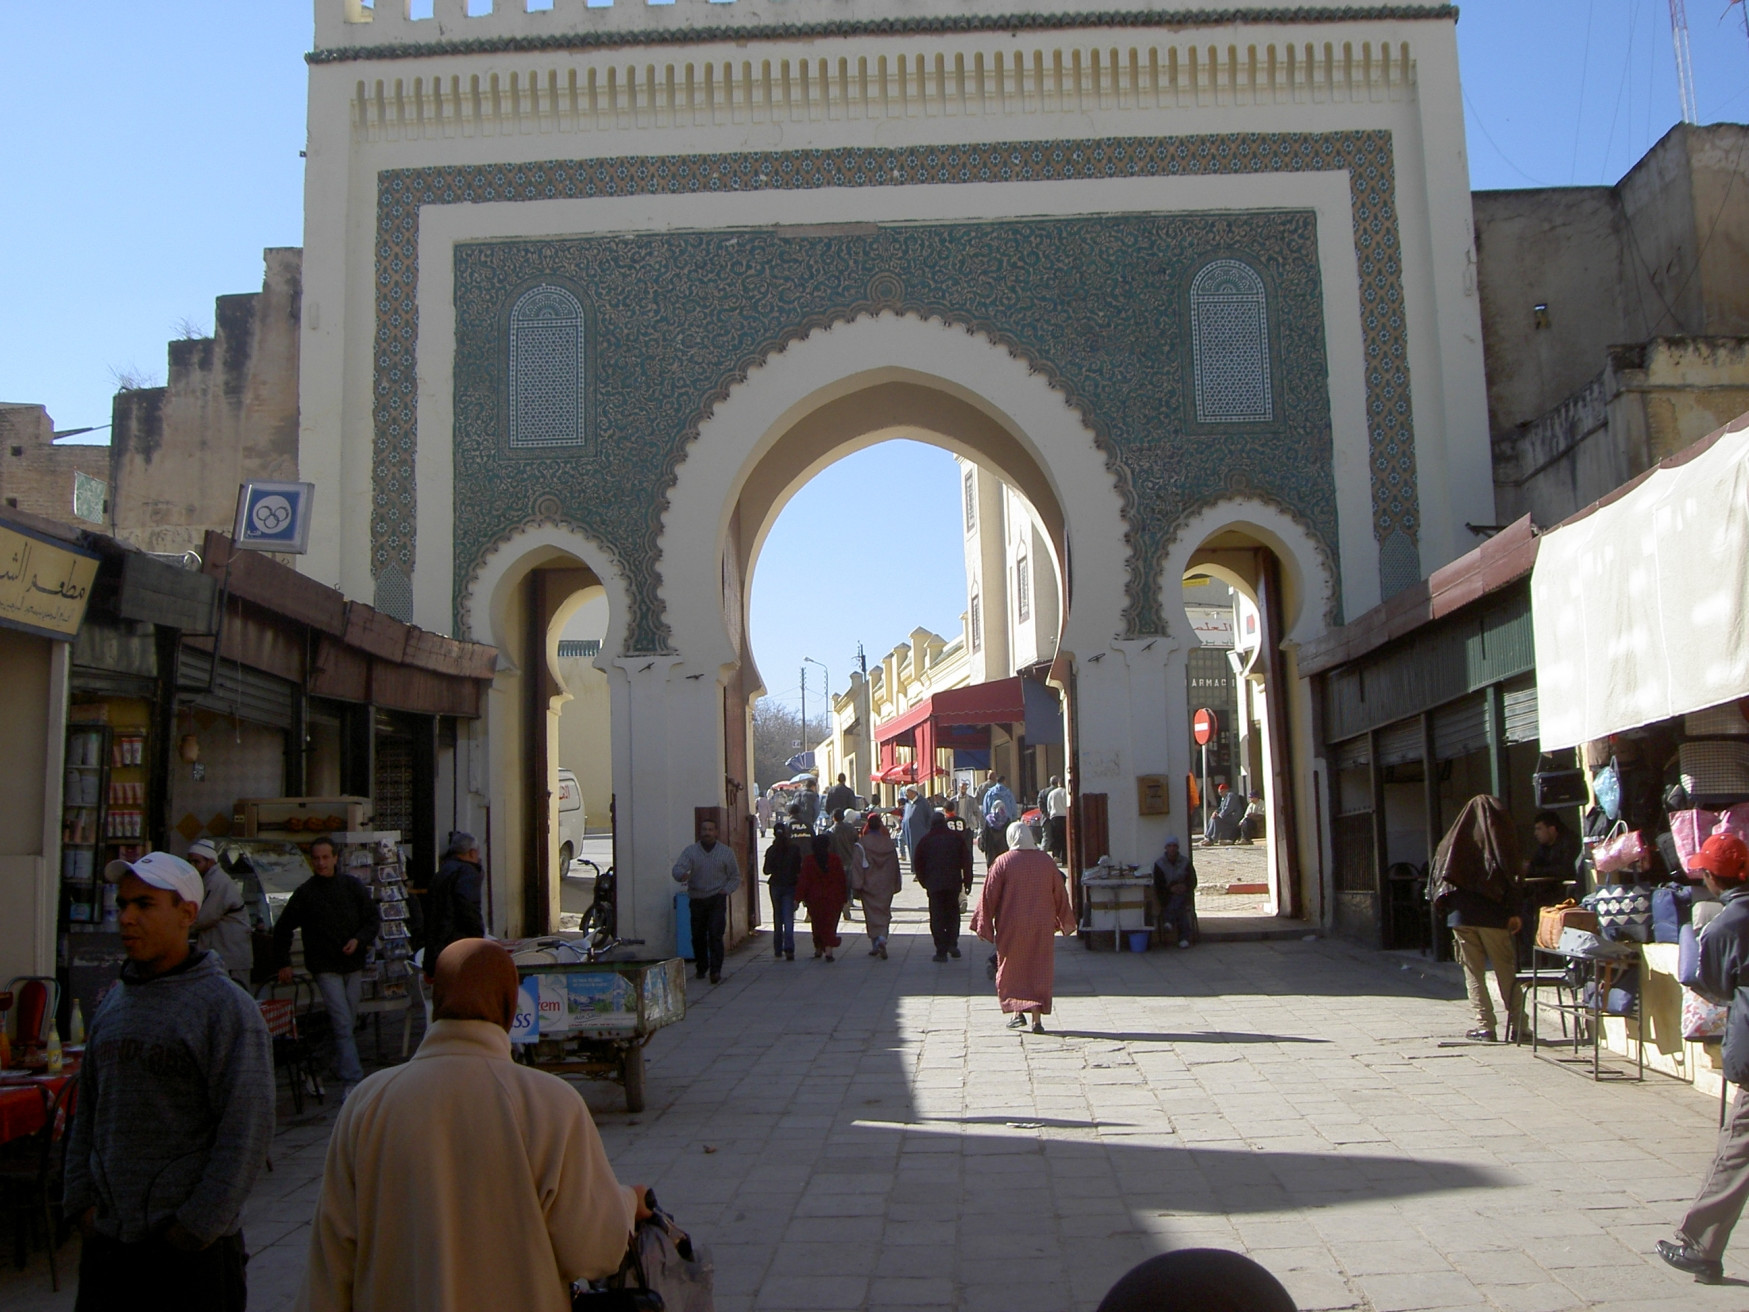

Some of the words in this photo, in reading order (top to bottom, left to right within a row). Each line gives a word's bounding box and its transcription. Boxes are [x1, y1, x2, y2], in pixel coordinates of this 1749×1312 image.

[25, 558, 86, 601] مطعم
[1191, 678, 1235, 687] ARMACI
[947, 820, 964, 832] 69
